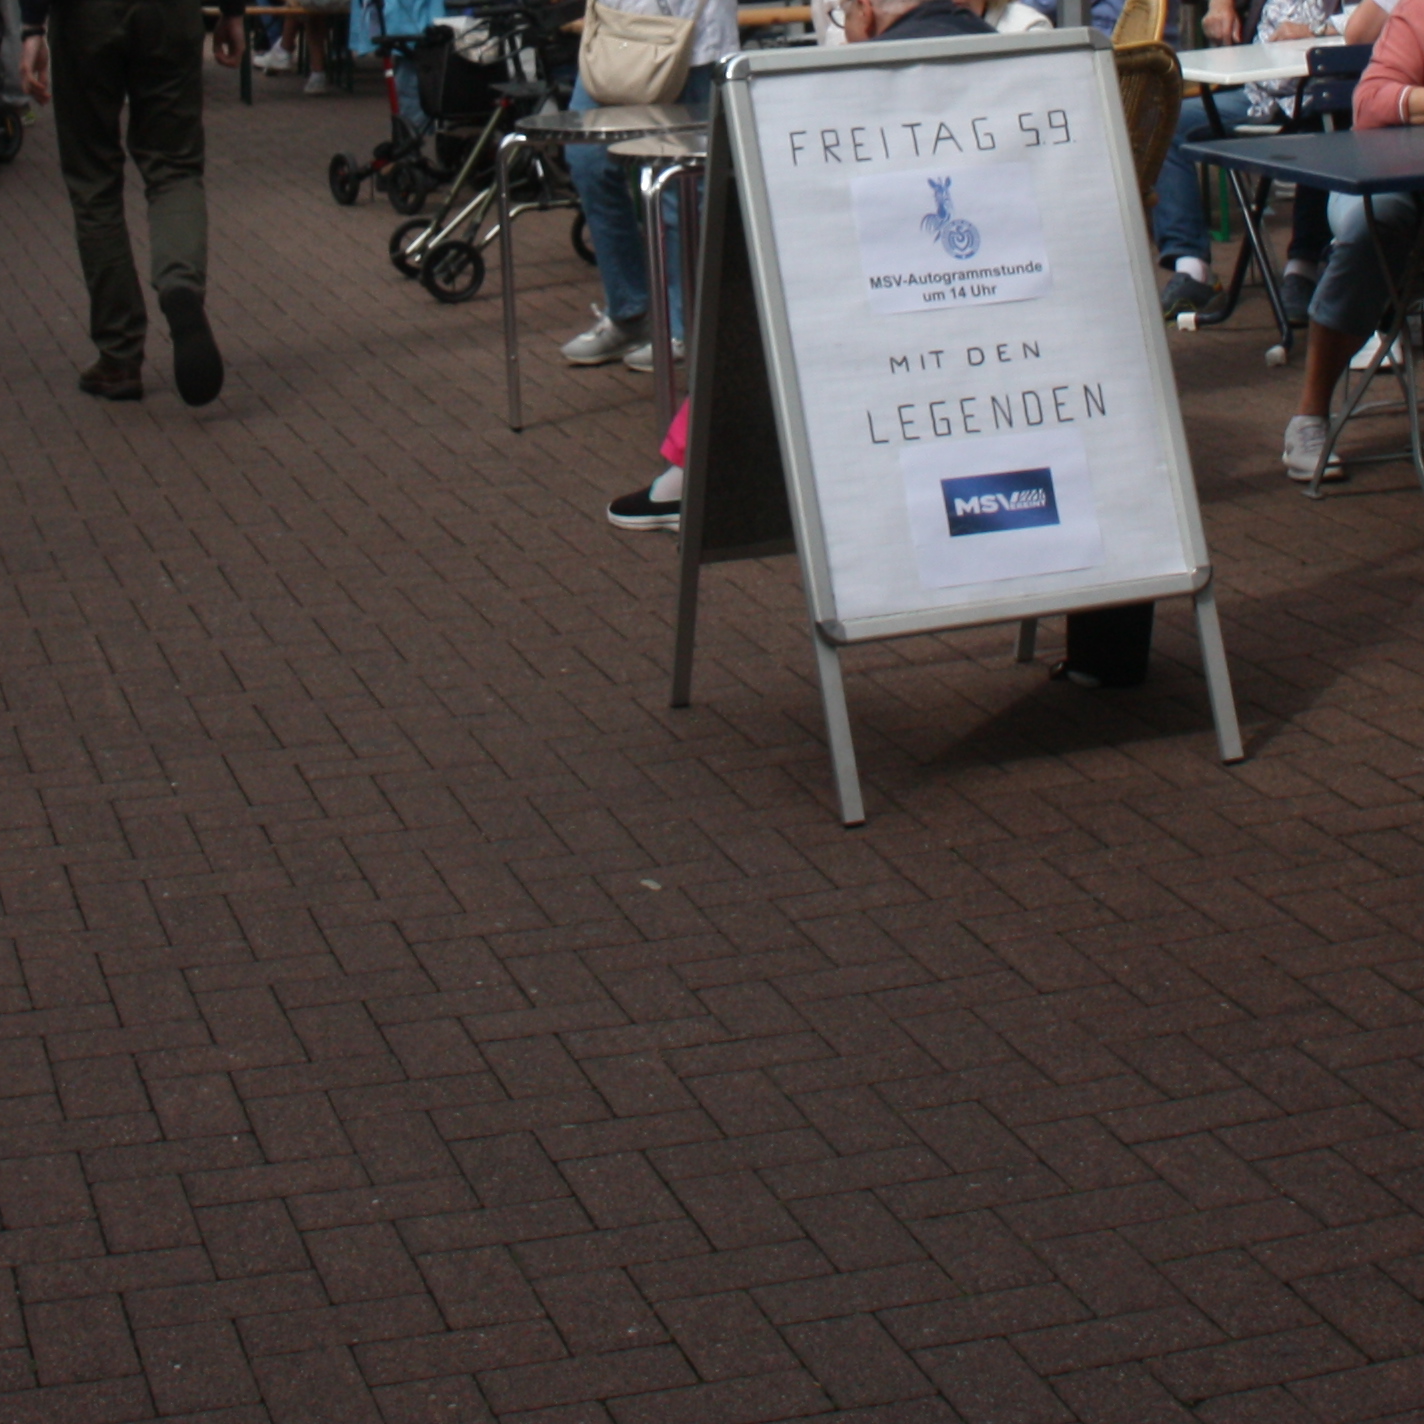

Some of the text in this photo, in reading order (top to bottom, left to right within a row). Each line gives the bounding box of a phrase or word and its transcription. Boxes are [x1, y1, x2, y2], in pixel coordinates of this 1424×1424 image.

[789, 116, 997, 166] FREITAG
[869, 260, 1044, 290] MSV-Autogrammstunde
[923, 284, 998, 304] um 14 Uhr
[889, 341, 1042, 374] MIT DEN
[866, 382, 1107, 445] LEGENDEN
